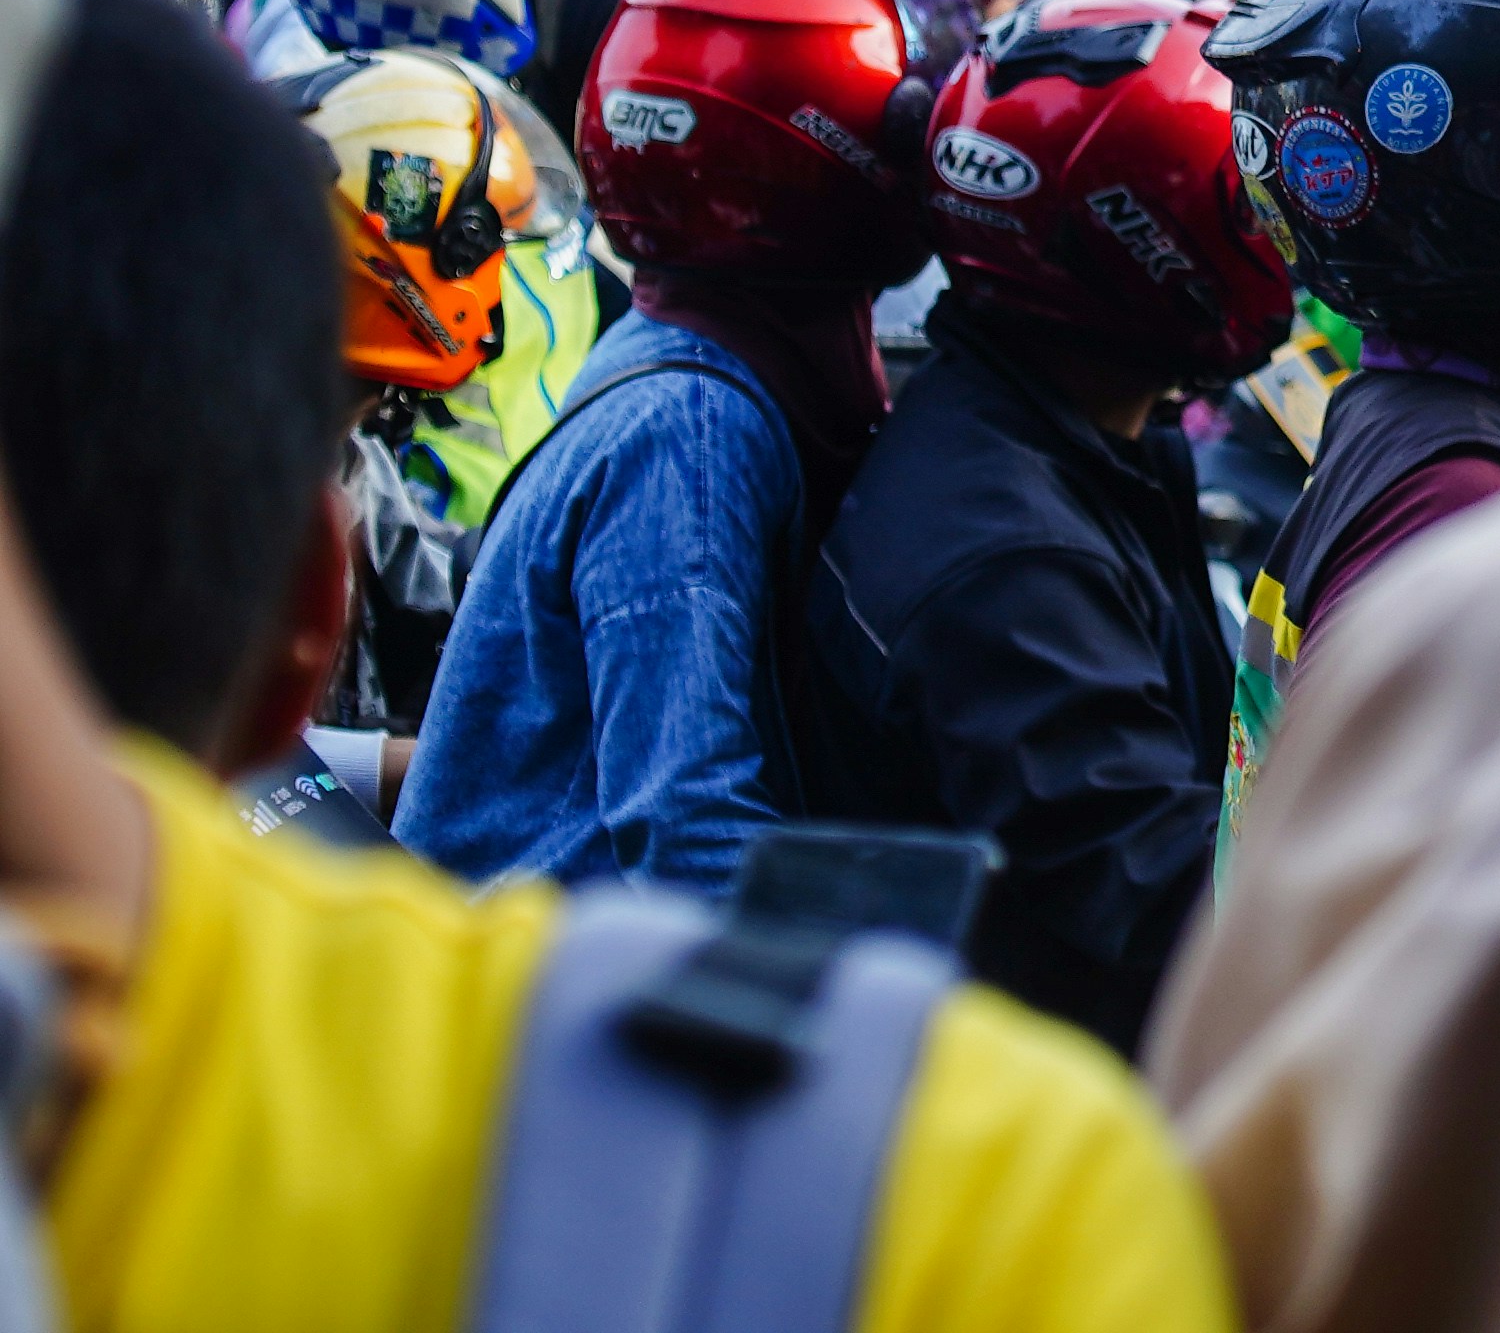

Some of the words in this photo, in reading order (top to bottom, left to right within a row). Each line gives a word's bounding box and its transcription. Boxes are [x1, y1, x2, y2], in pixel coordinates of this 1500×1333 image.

[610, 99, 687, 136] BMC
[940, 139, 1026, 186] NHK
[1085, 184, 1194, 283] NHK
